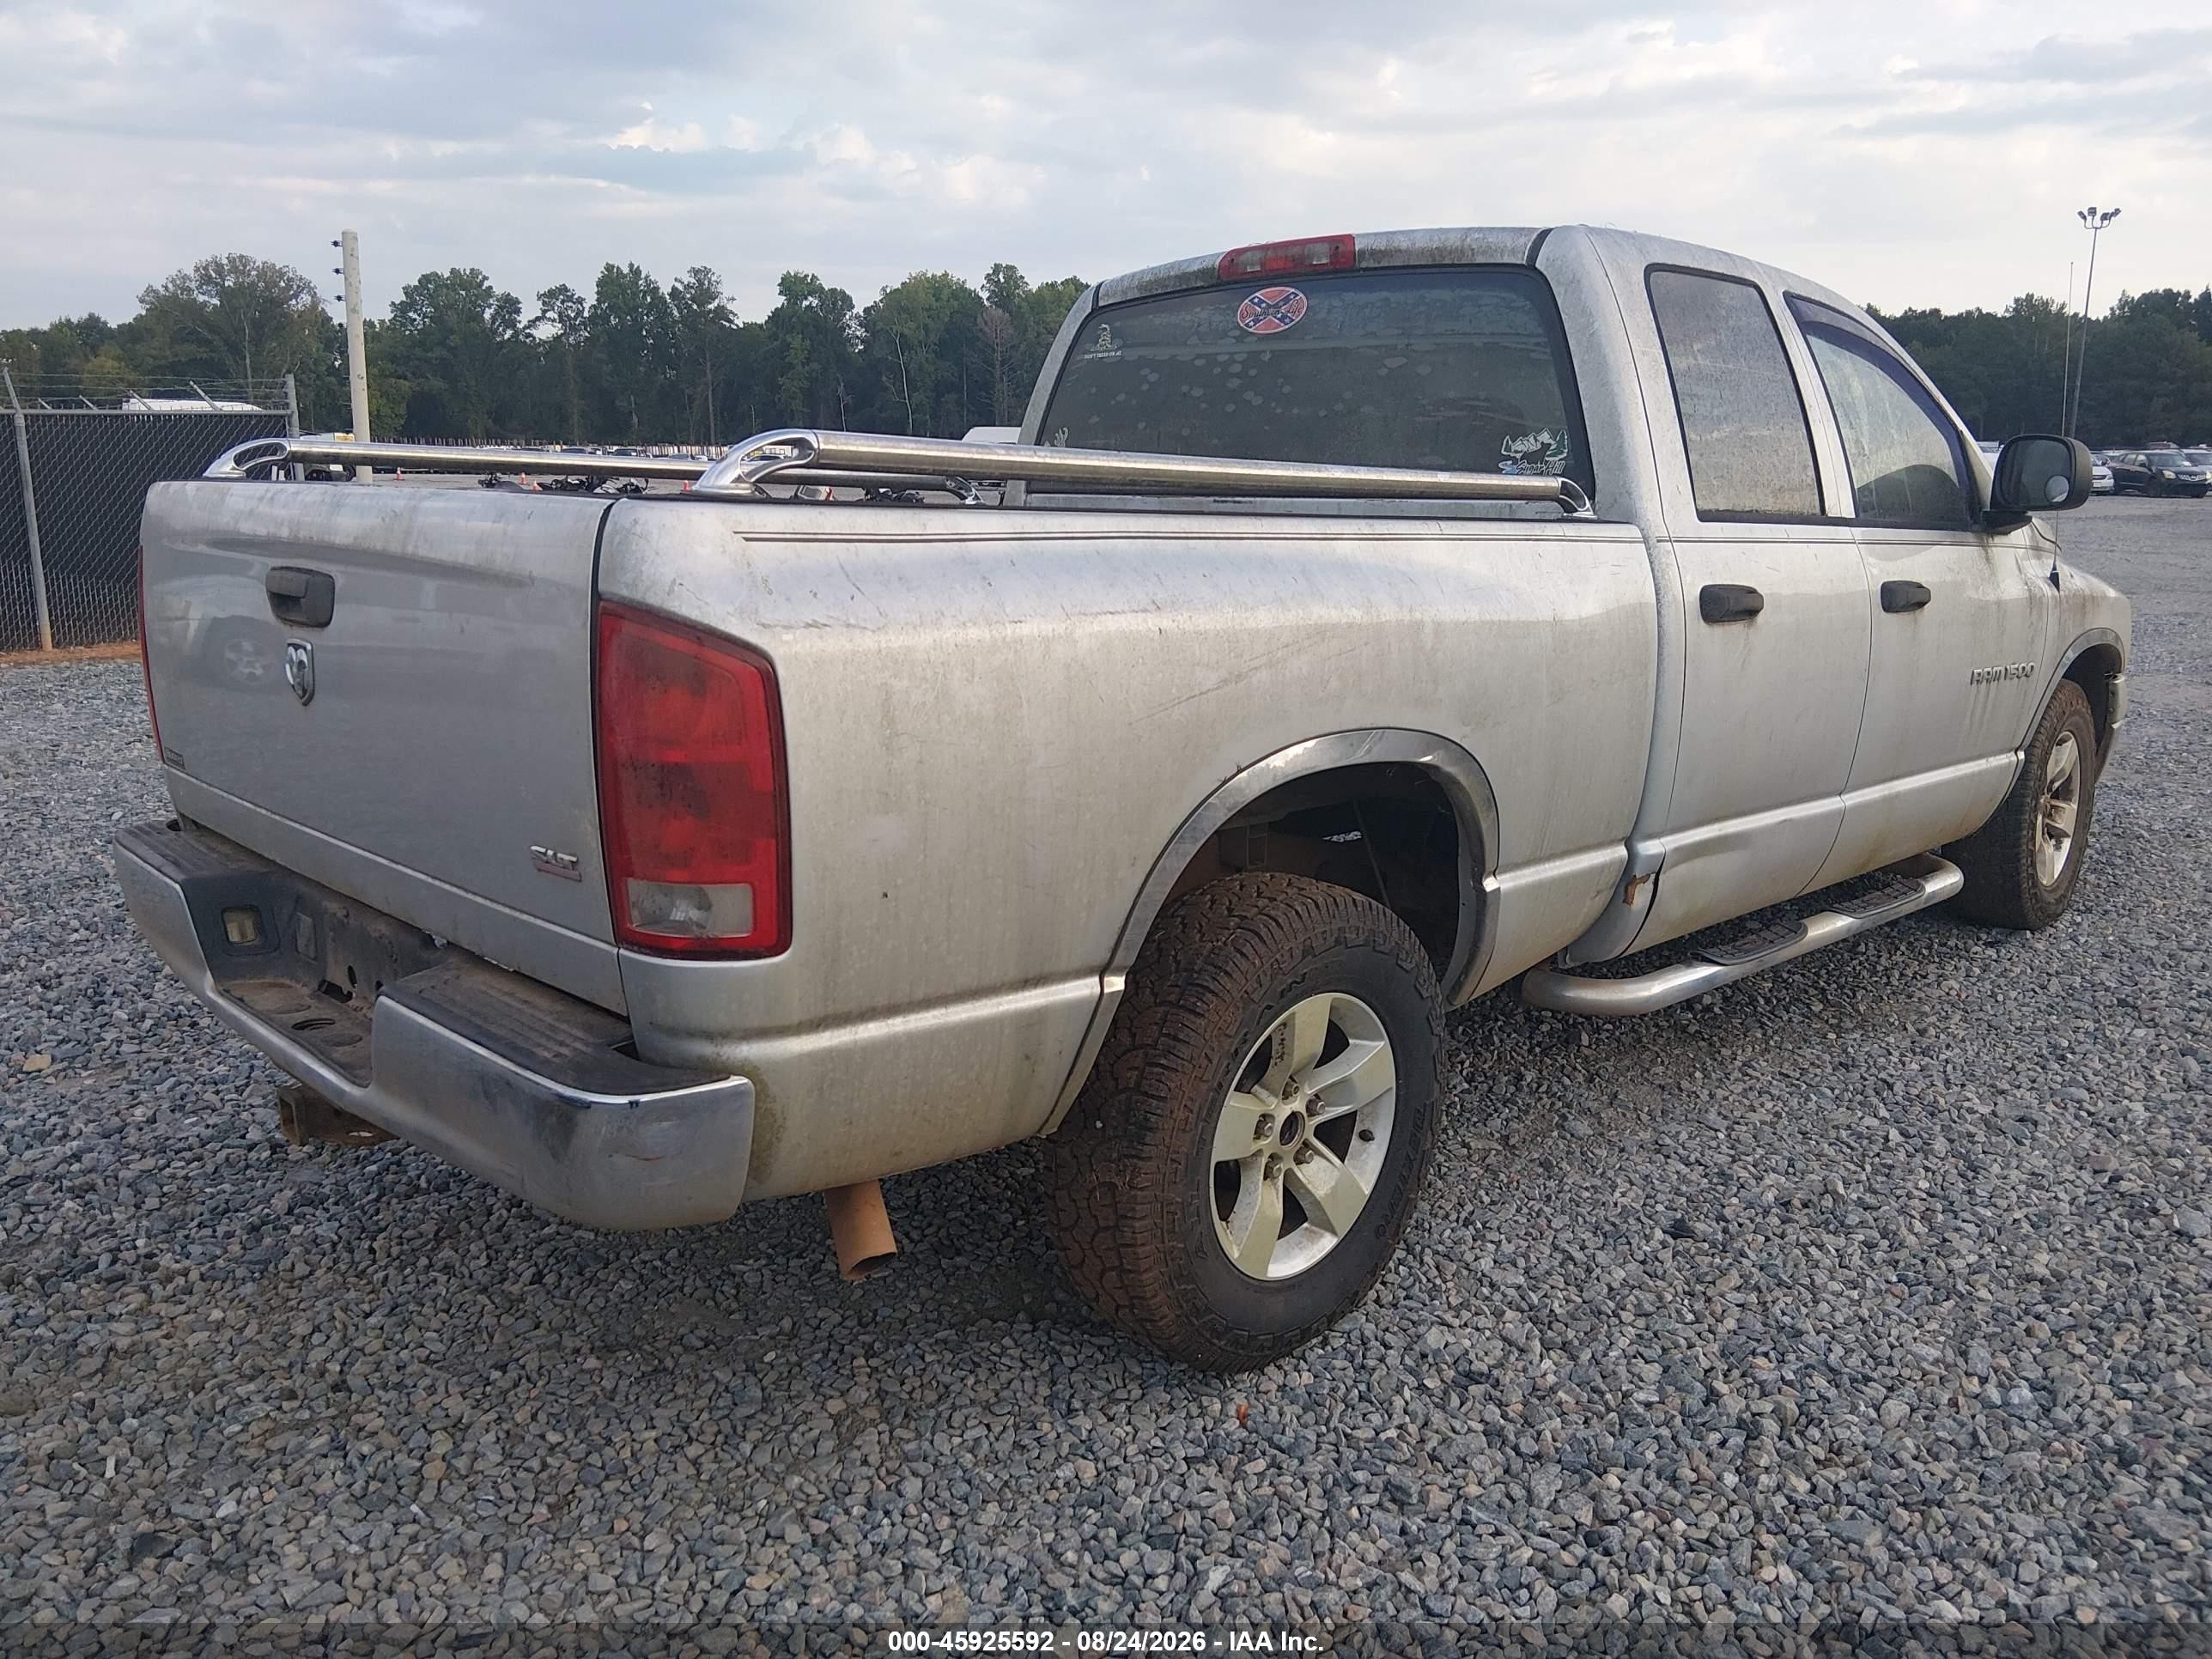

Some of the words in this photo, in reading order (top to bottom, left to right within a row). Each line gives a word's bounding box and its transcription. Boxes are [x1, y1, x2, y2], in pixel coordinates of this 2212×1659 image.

[1516, 459, 1546, 476] Sugar
[1545, 459, 1566, 476] Hill
[1970, 666, 2003, 686] RAM
[2003, 661, 2035, 681] 1500
